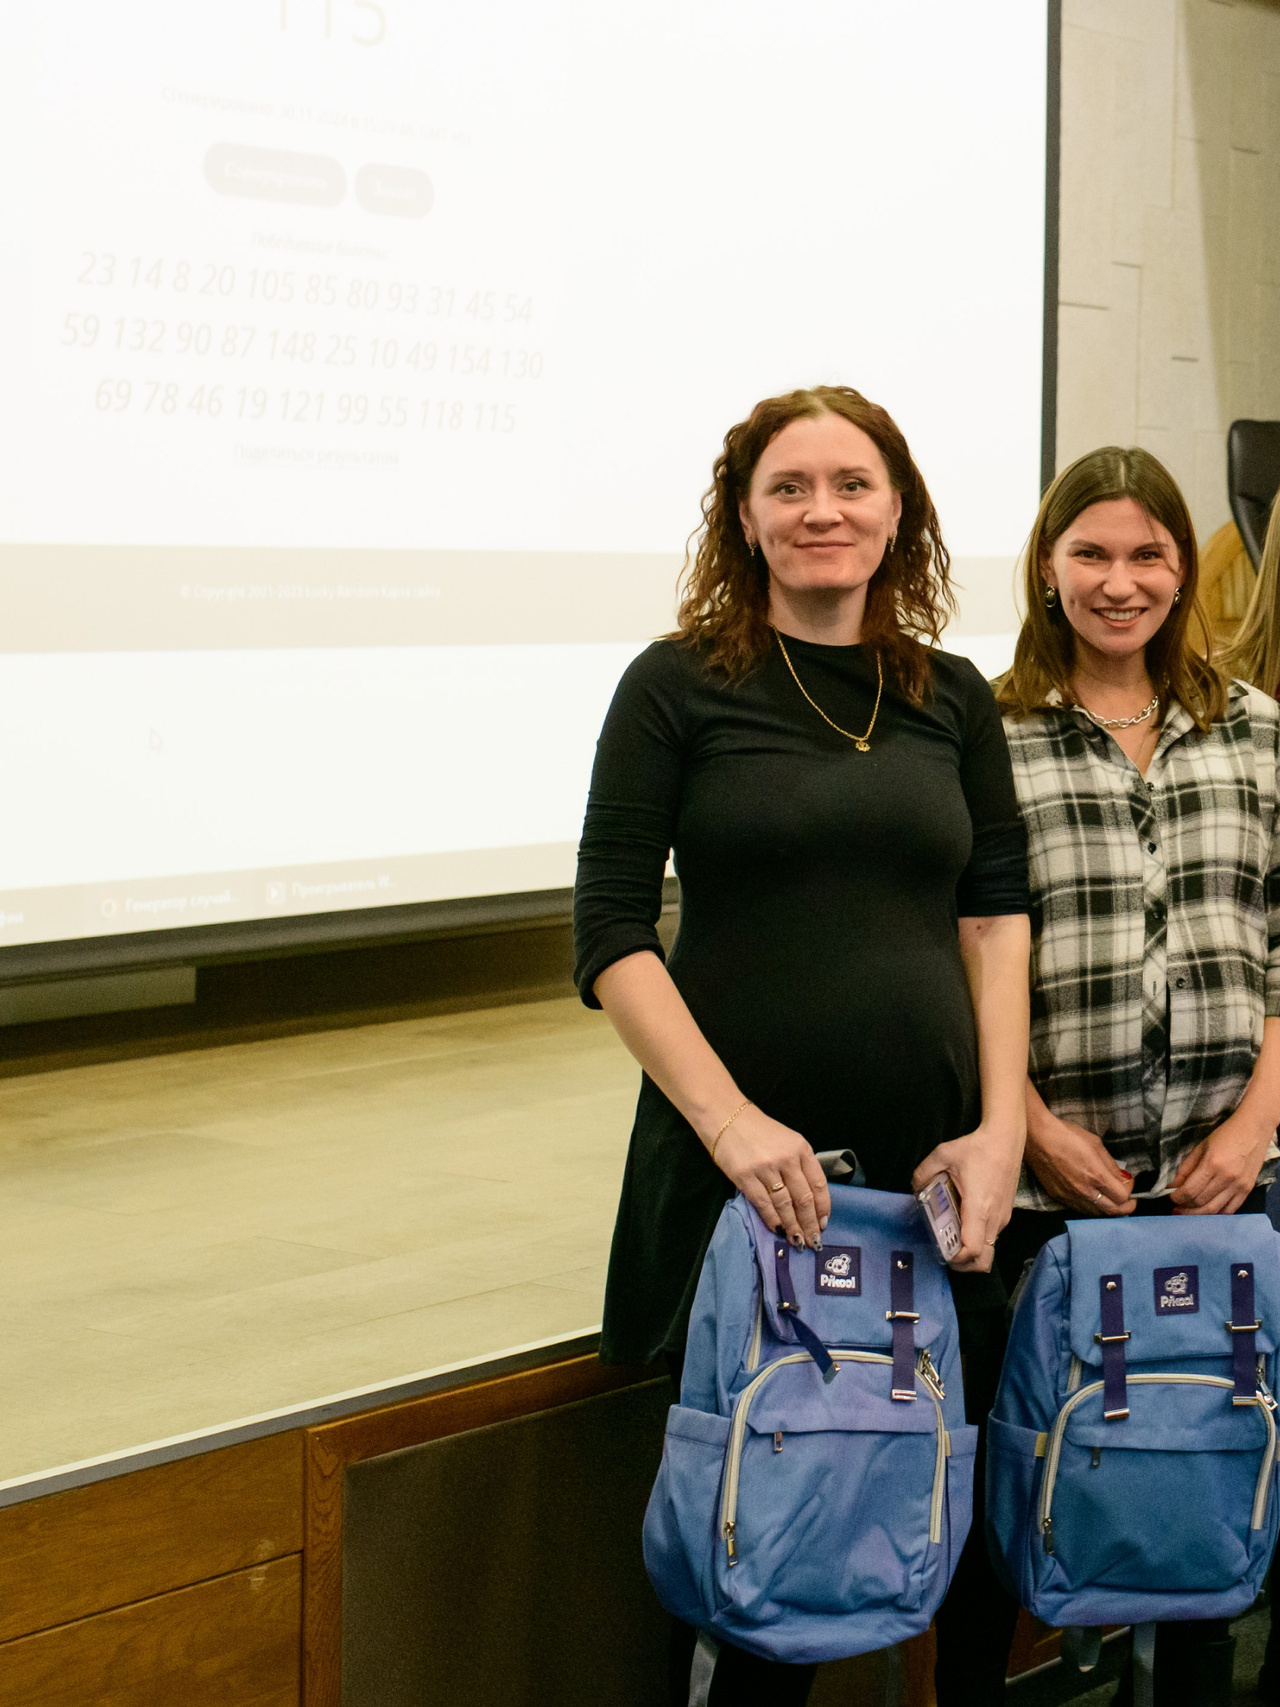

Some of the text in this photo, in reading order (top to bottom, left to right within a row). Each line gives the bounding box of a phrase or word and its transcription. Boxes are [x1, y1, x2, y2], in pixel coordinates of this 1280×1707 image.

[76, 249, 534, 324] 23 14 8 20 105 85 80 93 31 45 54
[59, 310, 545, 381] 59 132 90 87 148 25 10 49 154 130
[93, 376, 517, 435] 69 78 46 19 121 99 55 118 115
[820, 1273, 856, 1289] Pikool
[1160, 1293, 1194, 1308] Pikool
